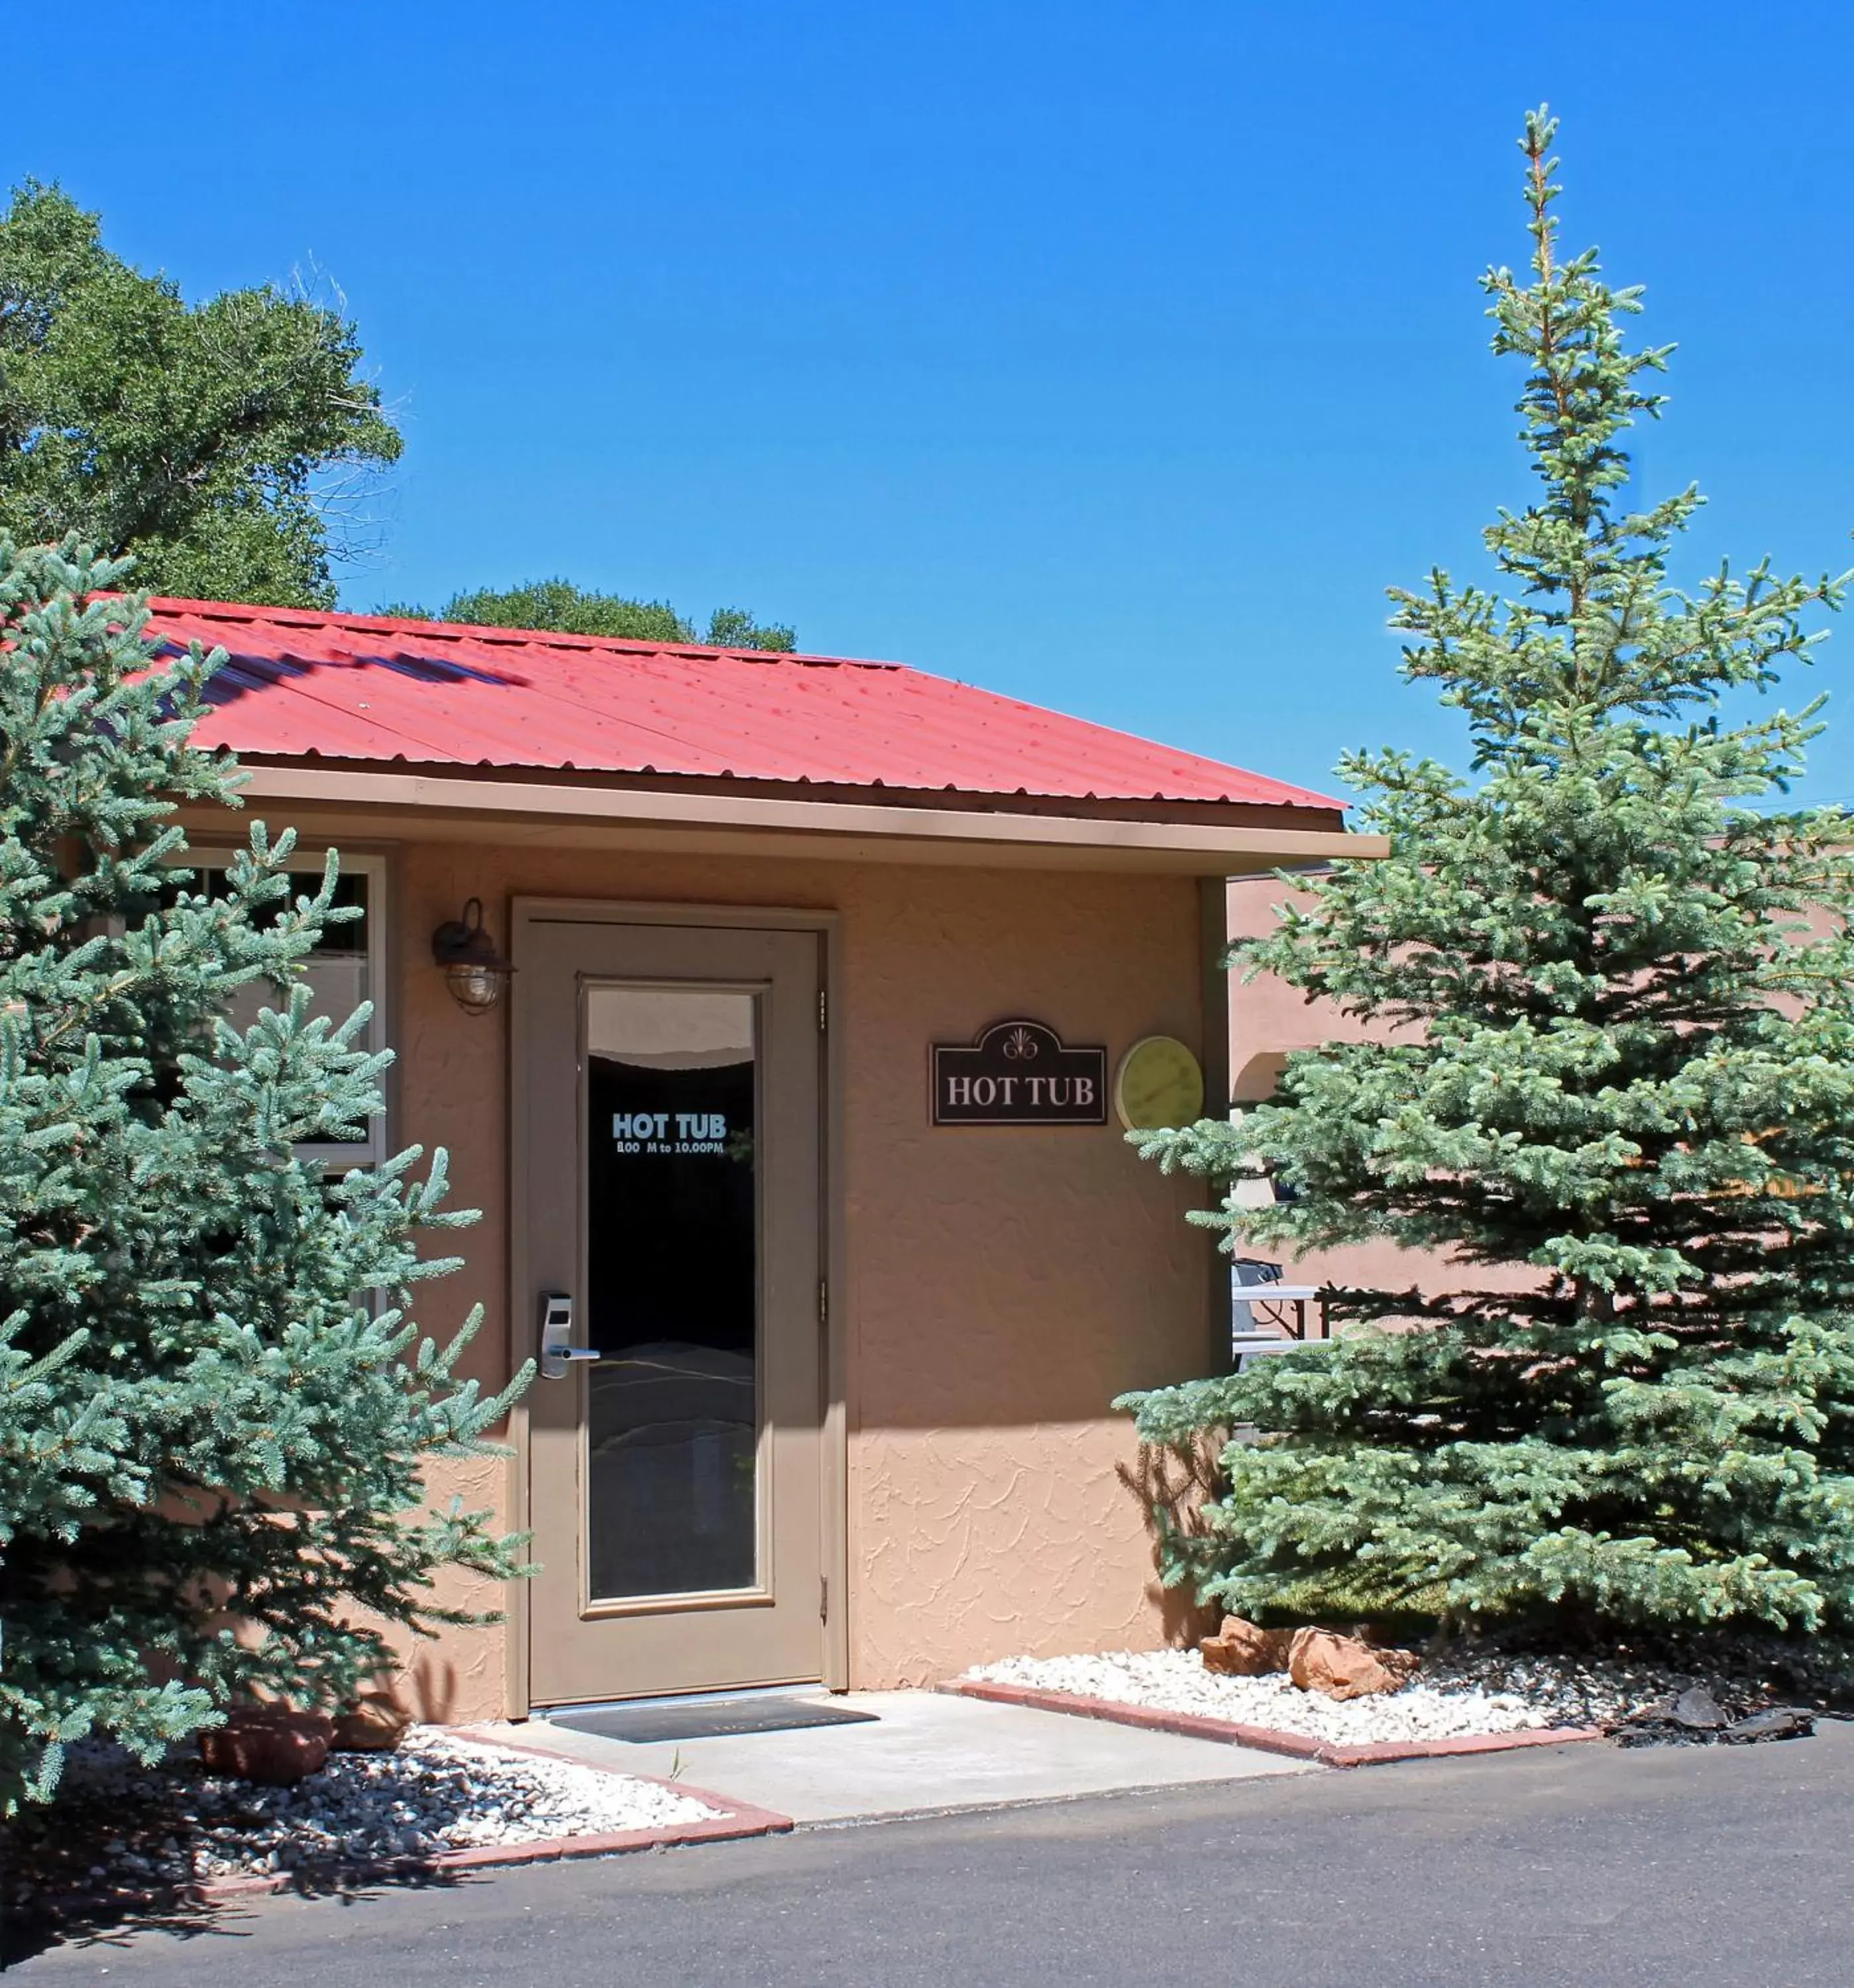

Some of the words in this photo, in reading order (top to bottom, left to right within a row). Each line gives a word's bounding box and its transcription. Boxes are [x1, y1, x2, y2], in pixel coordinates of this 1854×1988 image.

[948, 1077, 1018, 1105] HOT
[1025, 1077, 1094, 1105] TUB
[613, 1113, 669, 1138] HOT
[675, 1114, 726, 1138] TUB
[660, 1143, 671, 1153] to
[675, 1142, 724, 1153] 10.00PM
